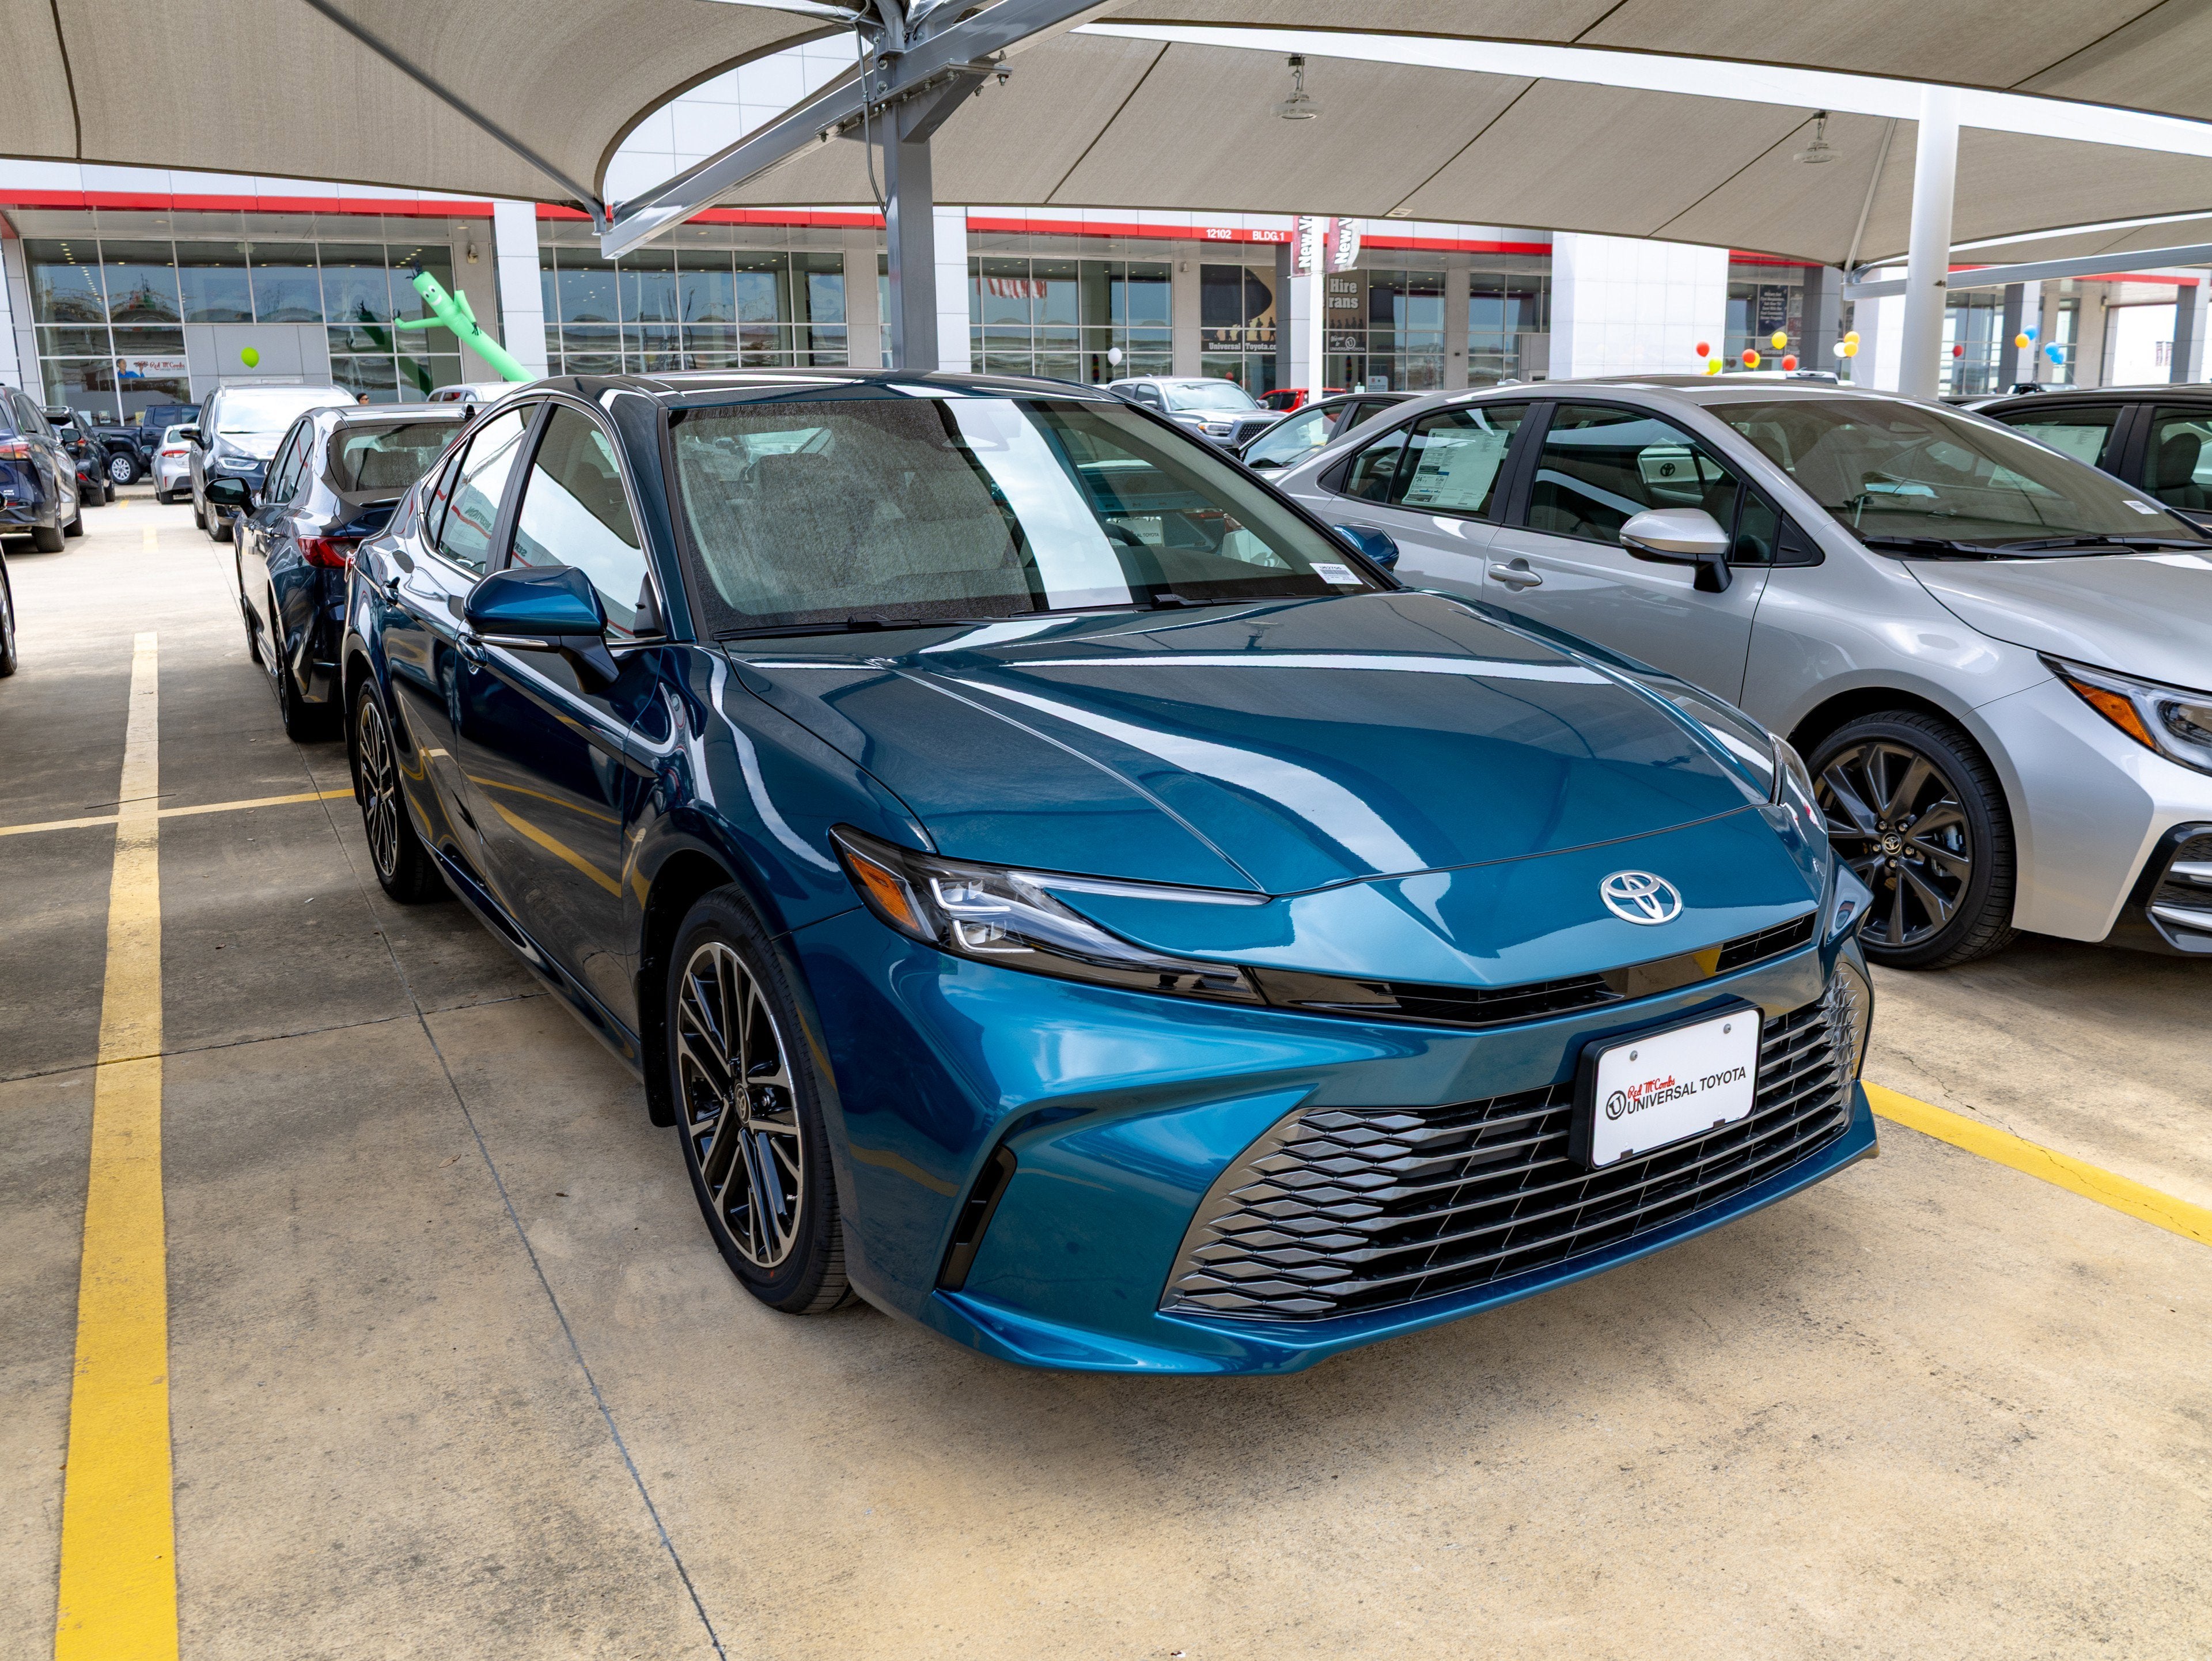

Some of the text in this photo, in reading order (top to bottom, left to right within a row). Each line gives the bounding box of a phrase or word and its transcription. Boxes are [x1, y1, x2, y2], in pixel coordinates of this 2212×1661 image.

[1206, 229, 1232, 239] 12102
[1298, 233, 1312, 268] New
[1334, 229, 1352, 264] New
[1330, 278, 1357, 293] Hire
[1323, 297, 1358, 308] rans
[150, 361, 160, 370] Red
[1627, 1074, 1675, 1102] Red McCombs
[1627, 1081, 1697, 1114] UNIVERSAL
[1699, 1066, 1747, 1092] TOYOTA
